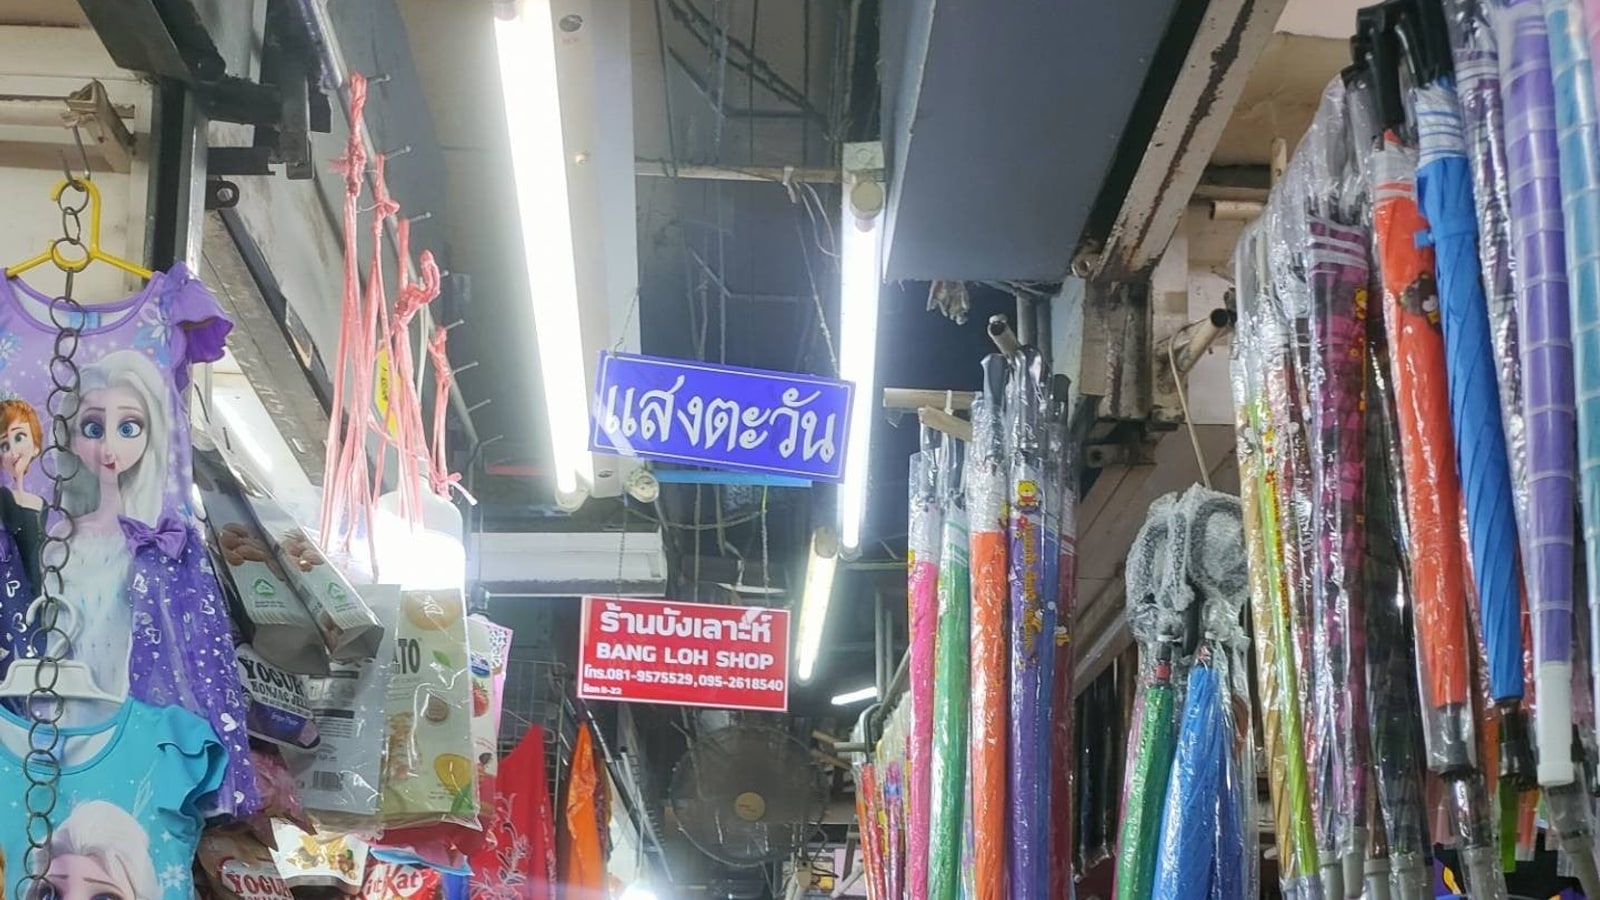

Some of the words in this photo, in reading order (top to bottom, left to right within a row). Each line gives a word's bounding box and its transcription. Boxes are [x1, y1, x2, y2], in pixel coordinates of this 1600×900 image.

[604, 375, 836, 463] แสงตะวัน
[596, 643, 656, 662] BANG
[664, 647, 708, 666] LOH
[715, 651, 774, 671] SHOP
